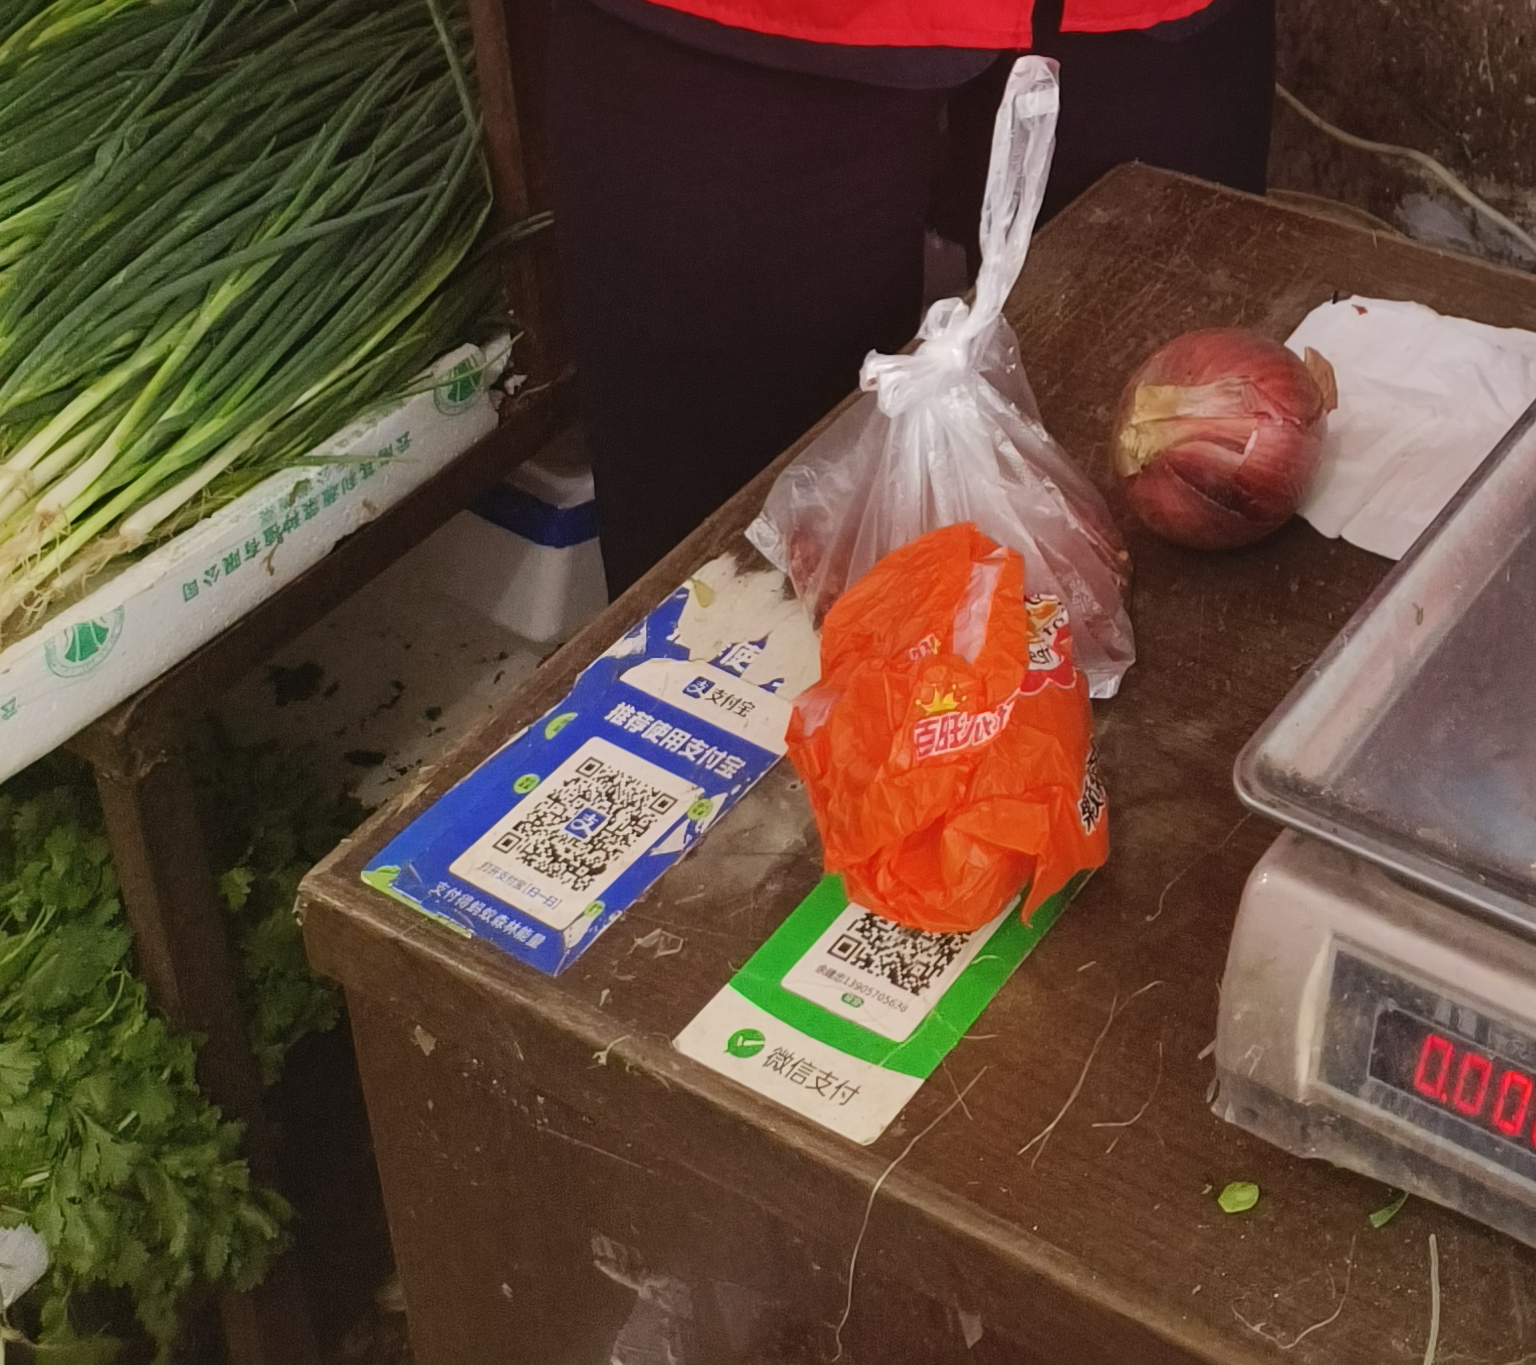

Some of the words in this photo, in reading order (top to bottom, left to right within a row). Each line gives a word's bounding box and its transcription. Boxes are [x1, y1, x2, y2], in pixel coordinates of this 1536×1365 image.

[706, 687, 757, 719] 支付宝
[602, 700, 747, 780] 推荐使用支付宝
[427, 880, 547, 952] 支付得蚂蚁森林能量
[761, 1046, 862, 1107] 微信支付
